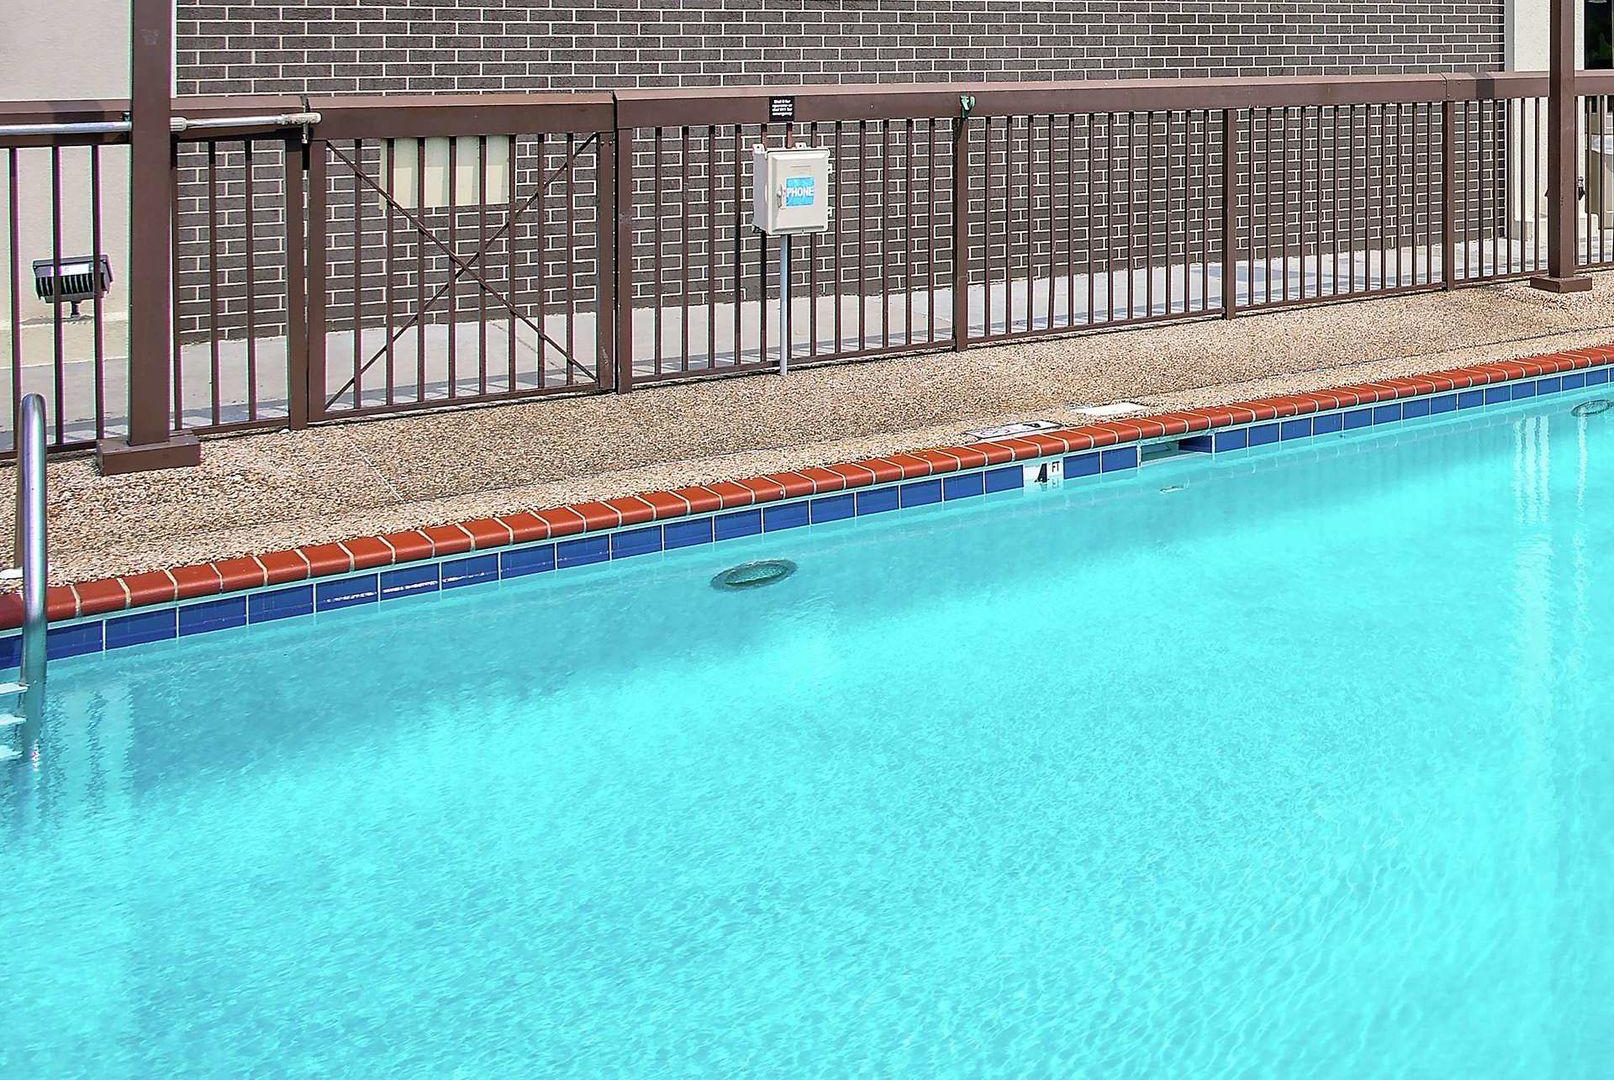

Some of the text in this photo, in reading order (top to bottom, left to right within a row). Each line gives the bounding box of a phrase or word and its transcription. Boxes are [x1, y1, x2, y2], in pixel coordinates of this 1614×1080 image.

[786, 186, 814, 197] PHONE
[1035, 461, 1060, 483] 4 FT
